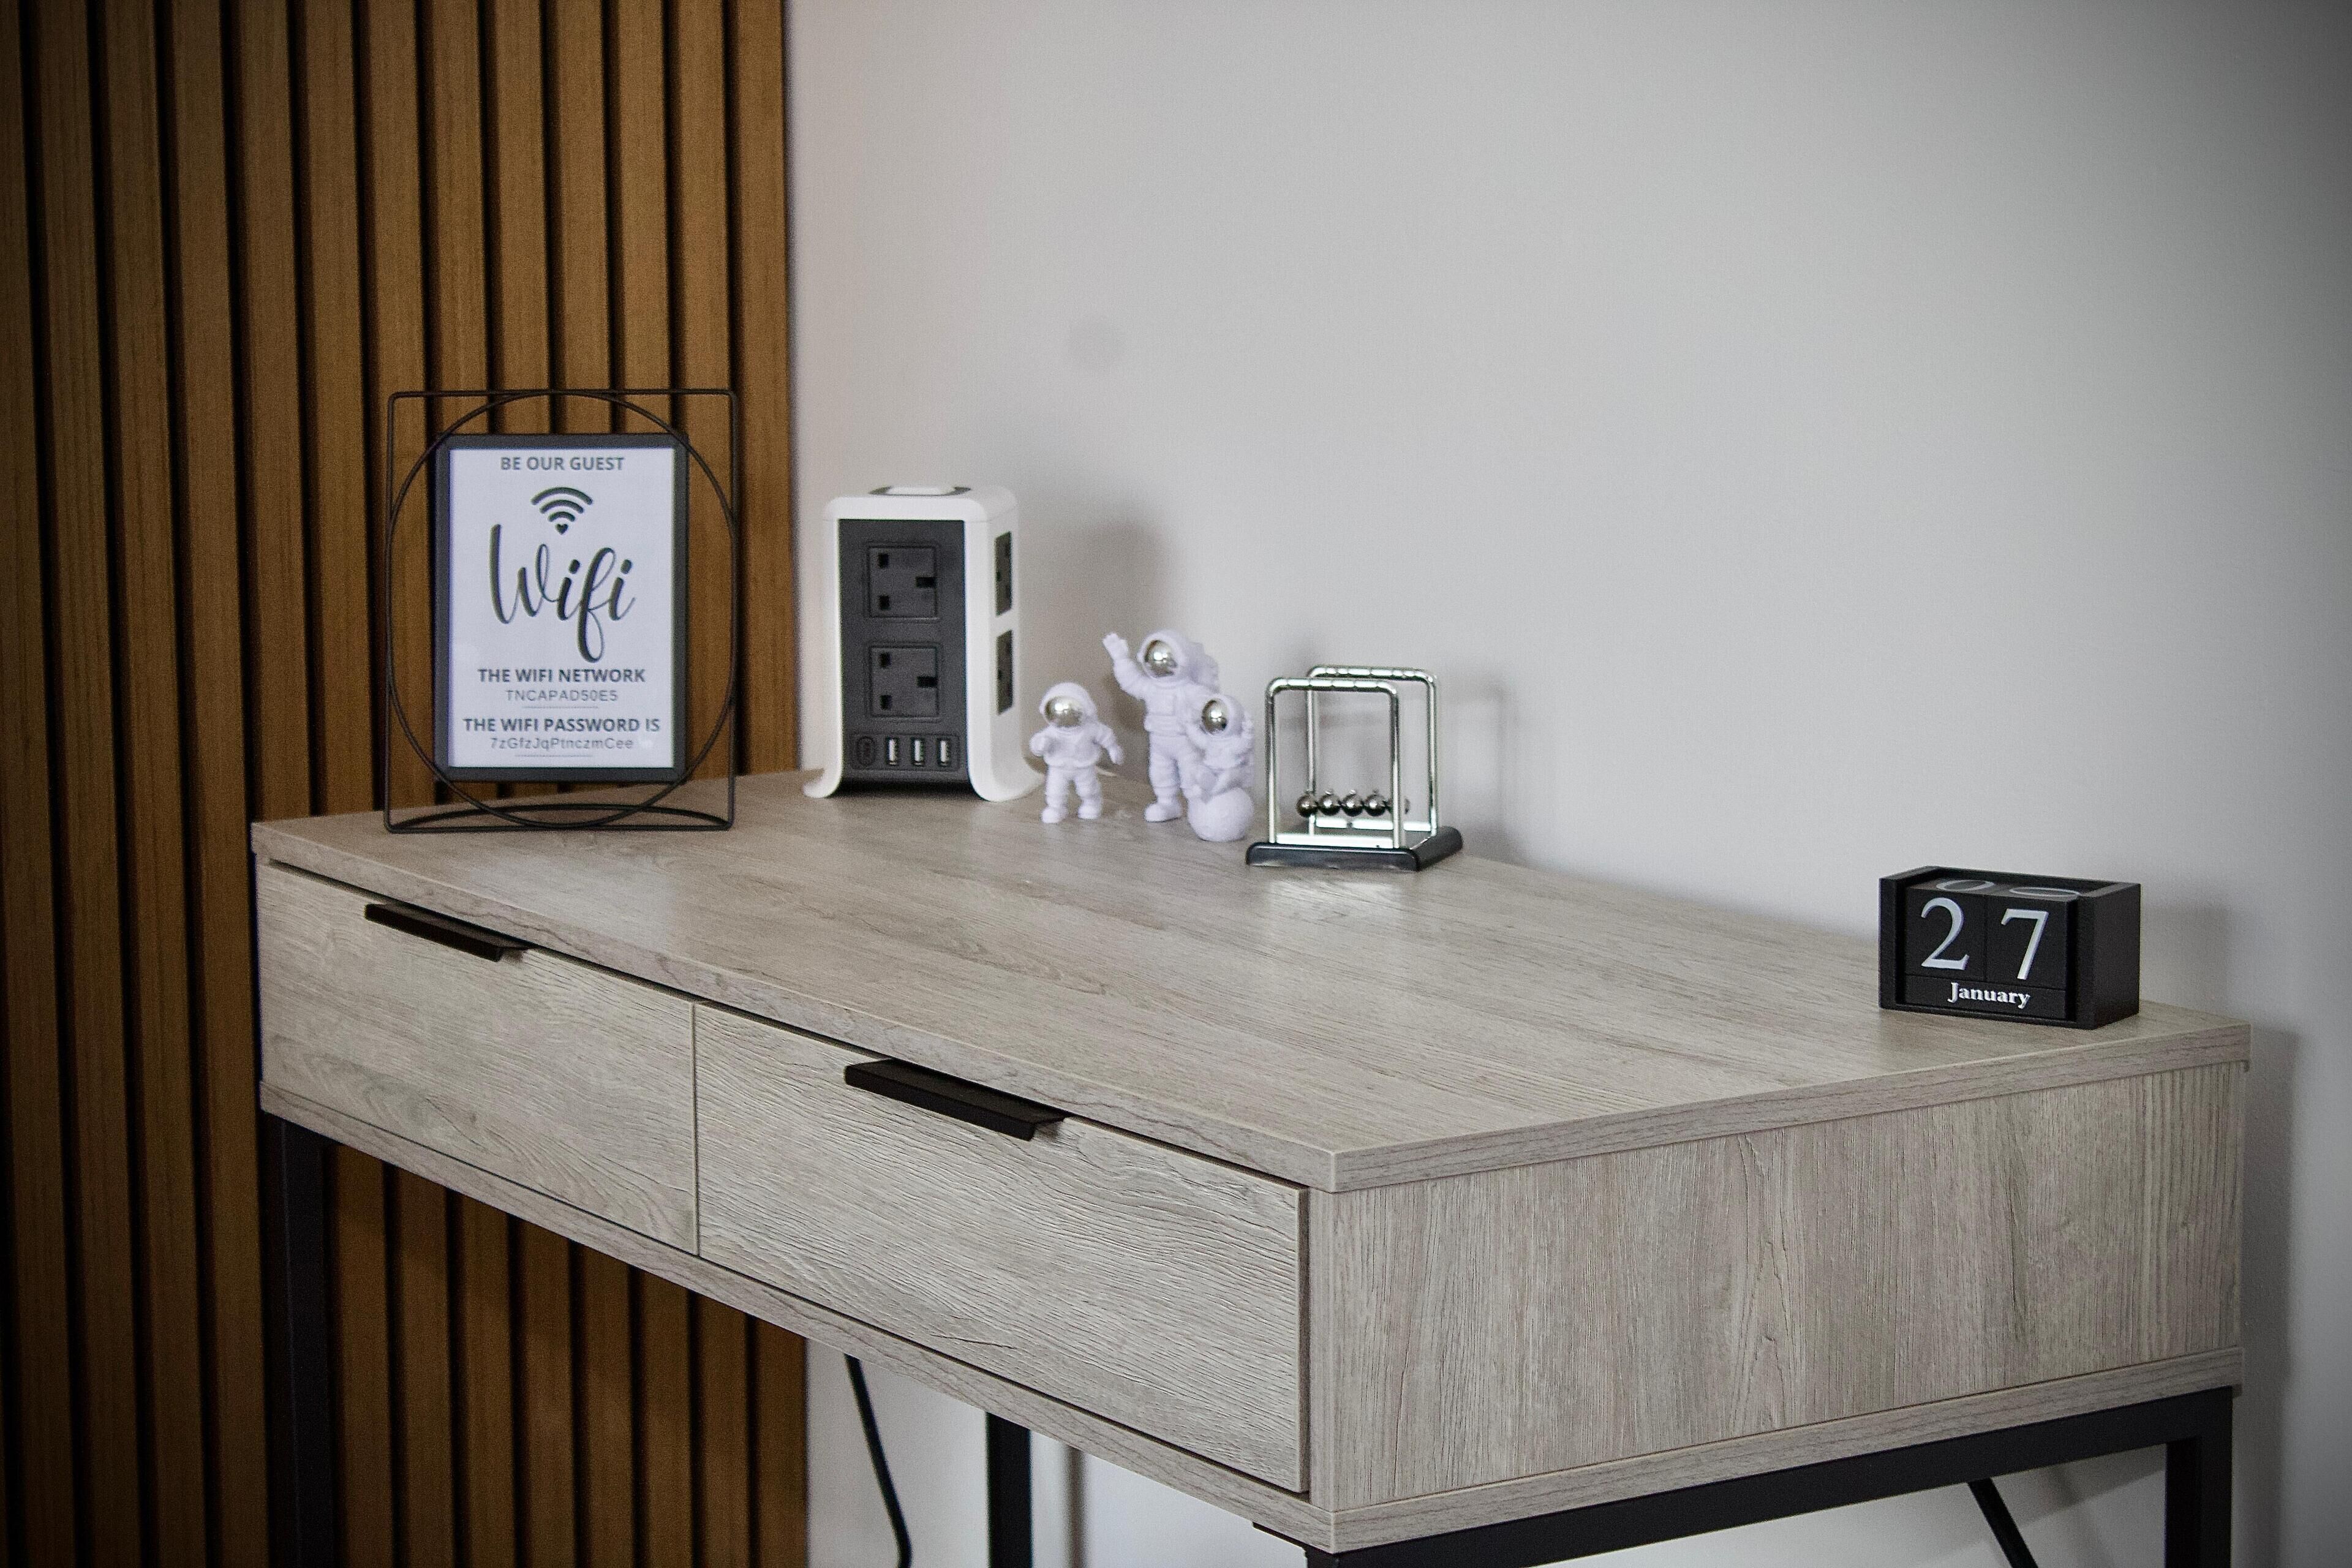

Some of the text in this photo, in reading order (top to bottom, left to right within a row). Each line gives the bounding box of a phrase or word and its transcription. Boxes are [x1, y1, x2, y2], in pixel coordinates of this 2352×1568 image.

[500, 456, 625, 471] BE OUR GUEST
[489, 524, 636, 663] Wifi
[478, 668, 646, 683] THE WIFI NETWORK
[464, 717, 660, 733] THE WIFI PASSWORD IS
[1947, 982, 2030, 1009] January
